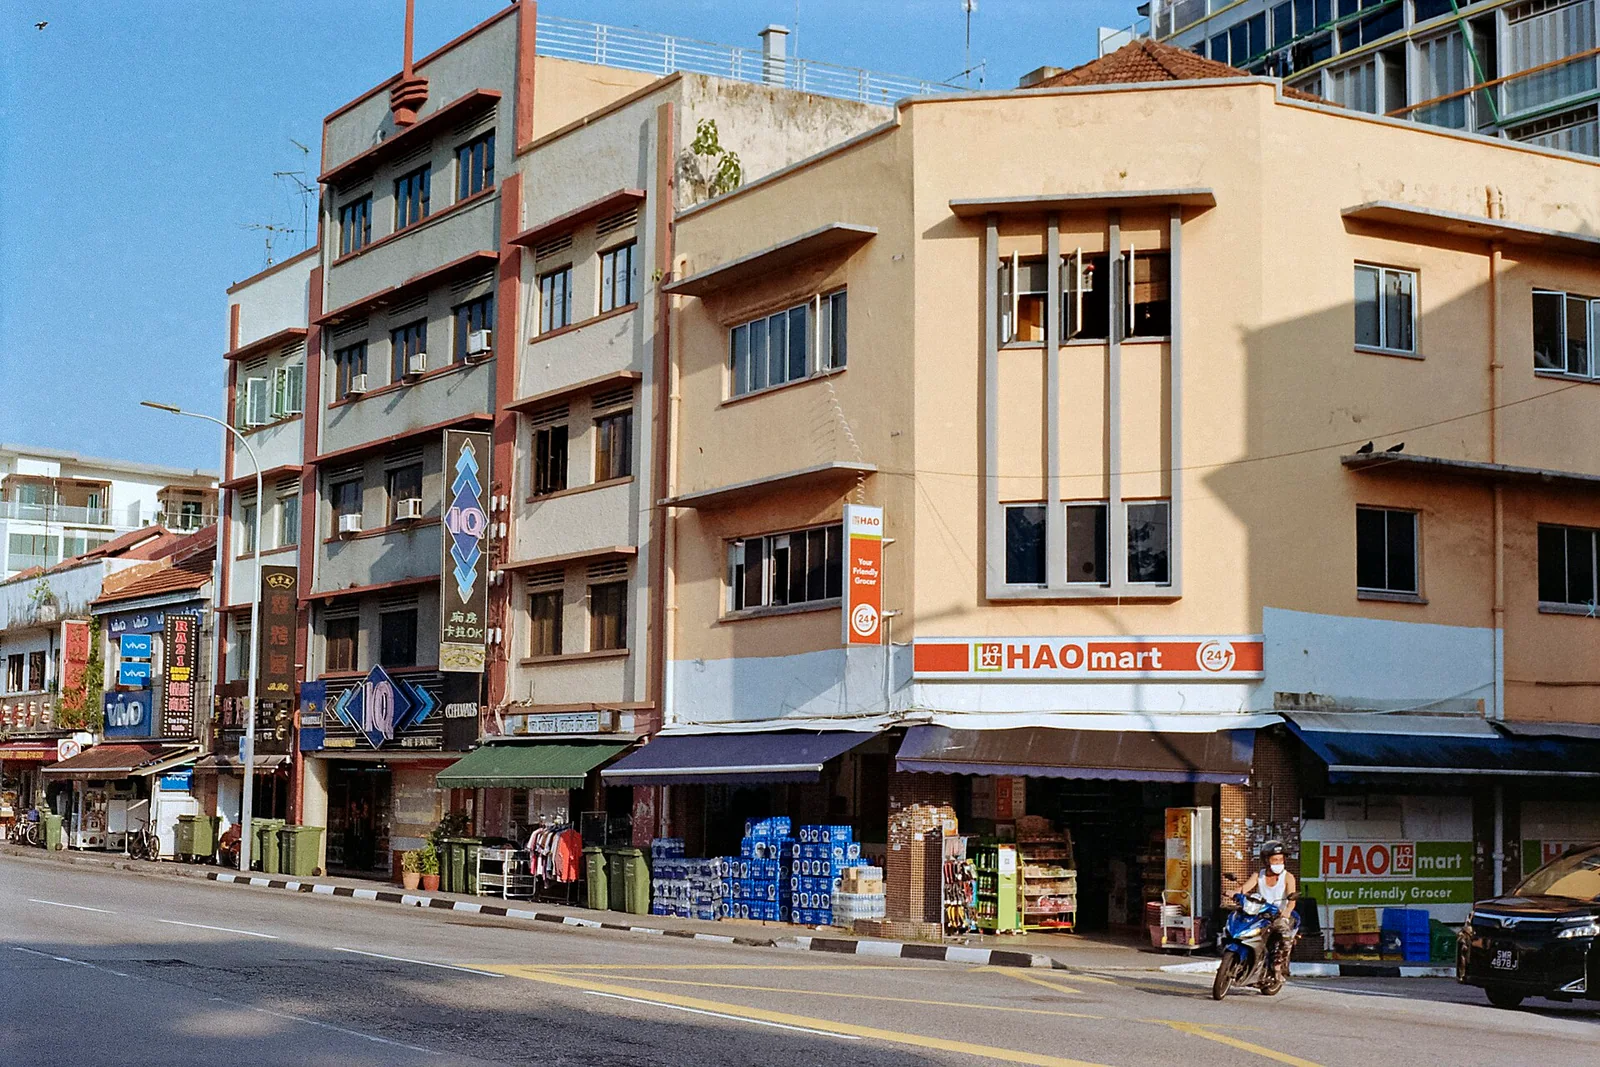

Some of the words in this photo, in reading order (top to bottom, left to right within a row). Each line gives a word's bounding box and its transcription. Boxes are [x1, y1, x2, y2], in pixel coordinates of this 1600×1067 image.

[860, 517, 880, 526] HAO
[858, 557, 873, 566] Your
[853, 567, 878, 577] Friendly
[854, 577, 876, 585] Grocer
[858, 614, 869, 623] 24
[125, 641, 147, 650] vivo
[982, 645, 1002, 665] 好
[1007, 644, 1084, 669] HAO
[1092, 647, 1162, 669] mart
[1206, 650, 1222, 660] 24
[124, 669, 146, 677] vivo
[106, 693, 143, 726] vivo
[362, 680, 394, 740] IQ
[1322, 845, 1390, 875] HAO
[1418, 853, 1461, 869] mart
[1326, 887, 1354, 899] Your
[1358, 887, 1406, 901] Friendly
[1411, 887, 1452, 898] Grocer
